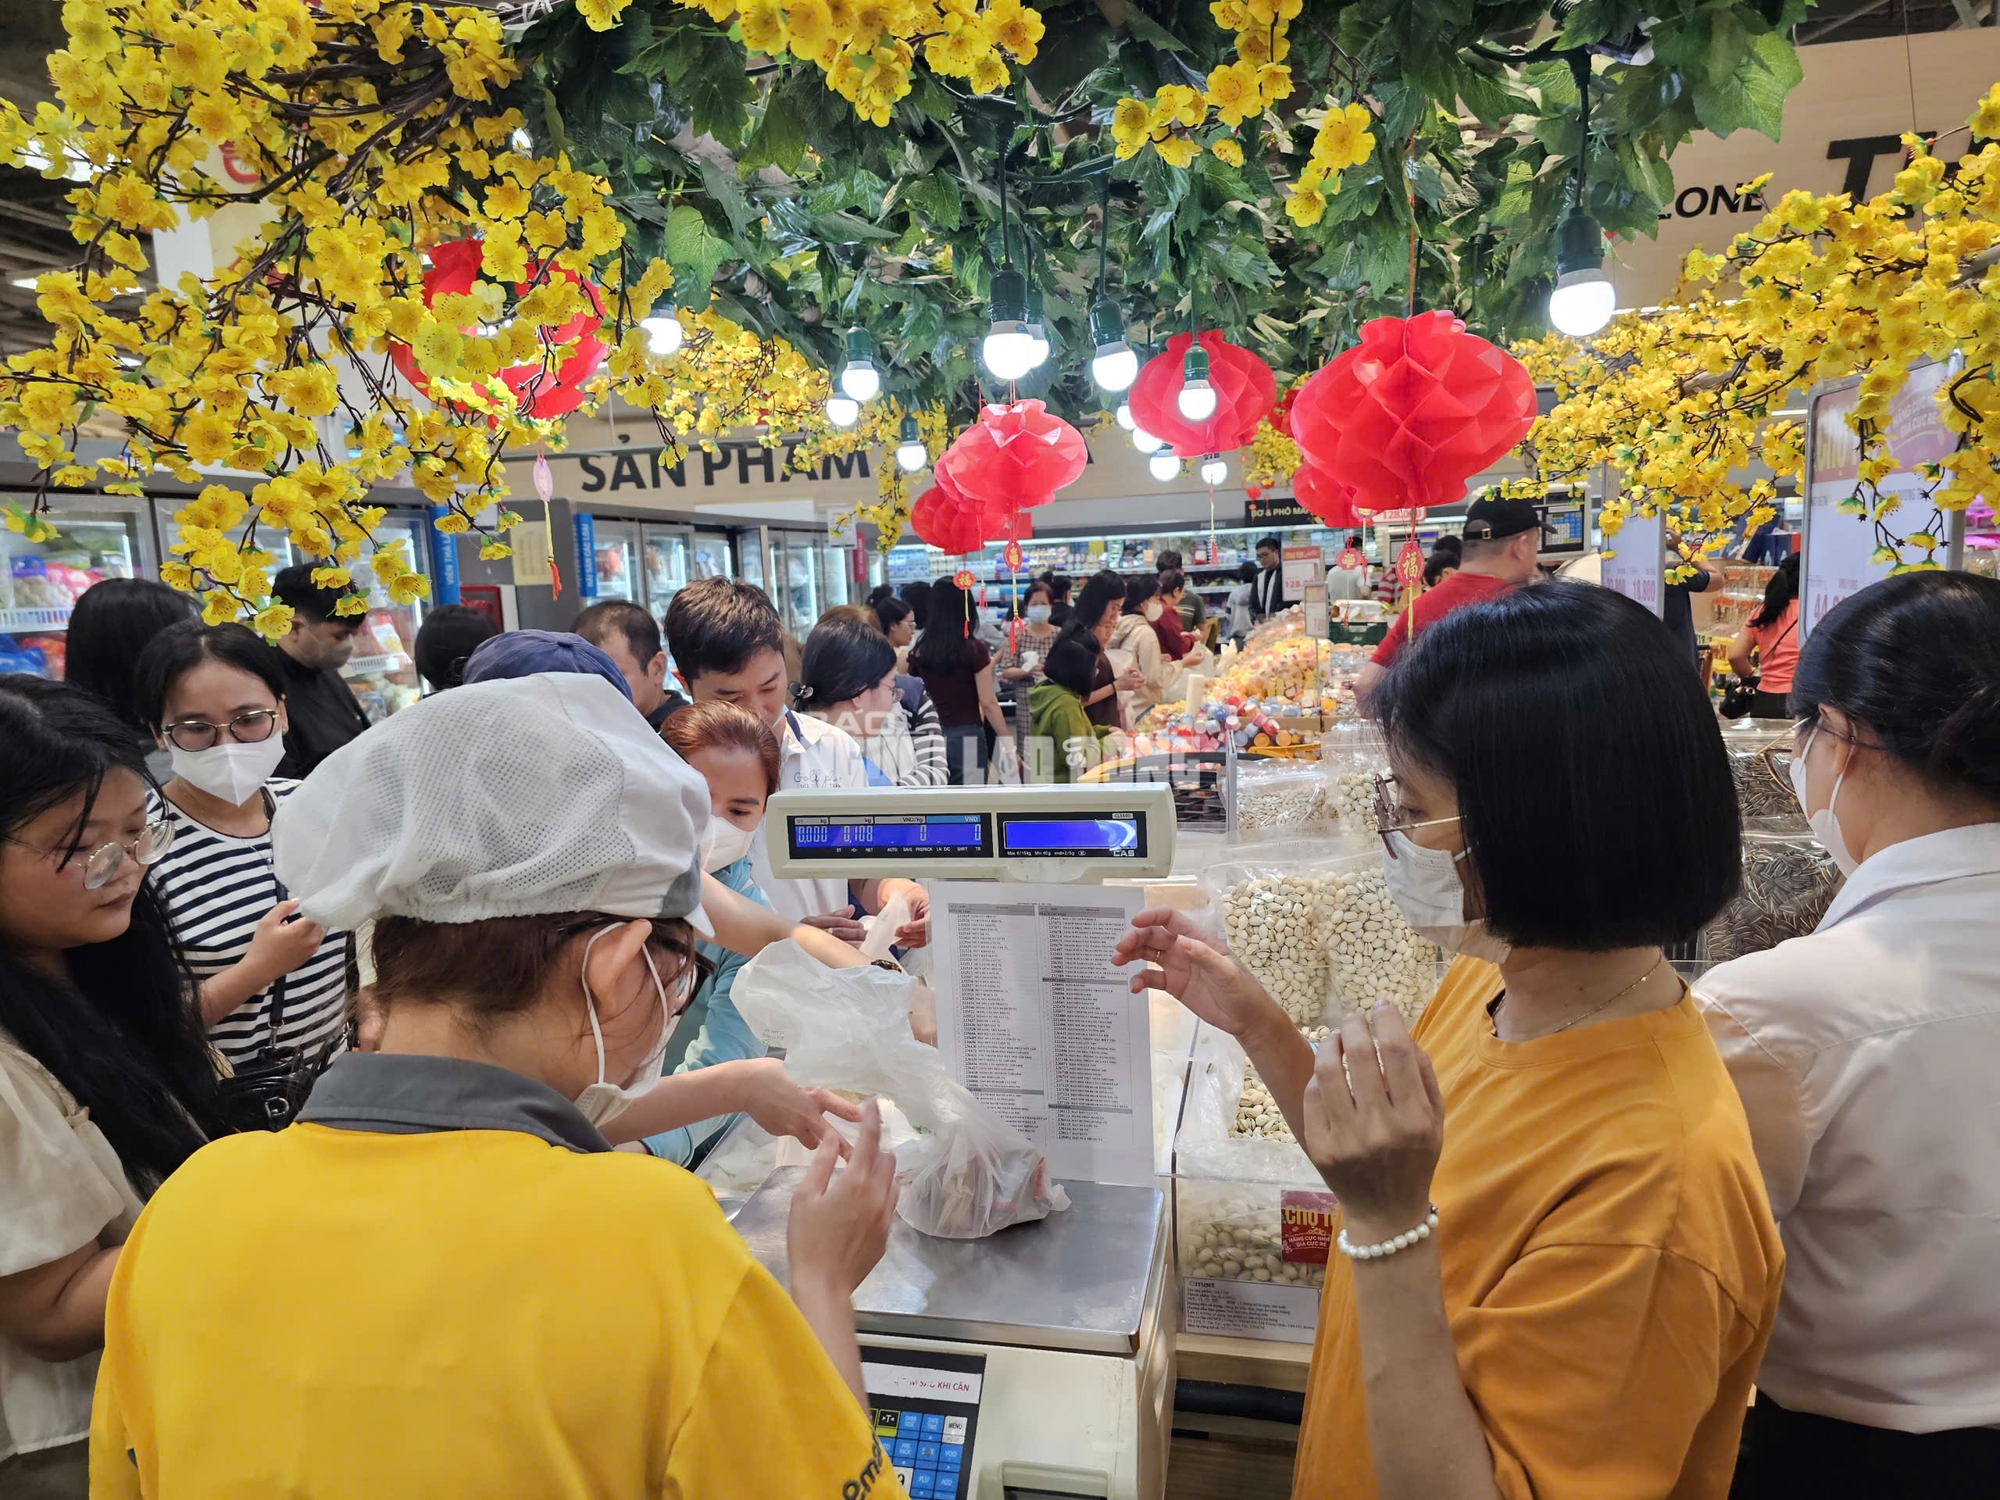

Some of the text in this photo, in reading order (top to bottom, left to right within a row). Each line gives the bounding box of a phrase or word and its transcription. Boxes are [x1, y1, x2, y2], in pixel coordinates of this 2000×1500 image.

[1658, 181, 1763, 219] ONE
[580, 434, 686, 492] SẢN
[1273, 506, 1291, 515] PHÔ
[1402, 551, 1419, 579] 福
[958, 574, 972, 587] 福
[793, 769, 821, 788] Golf
[1113, 849, 1135, 857] CAS
[1284, 1204, 1319, 1229] CHỢ
[937, 1381, 951, 1390] KHI
[948, 1422, 963, 1430] MENU
[919, 1475, 930, 1484] PLU
[940, 1478, 953, 1486] ADD
